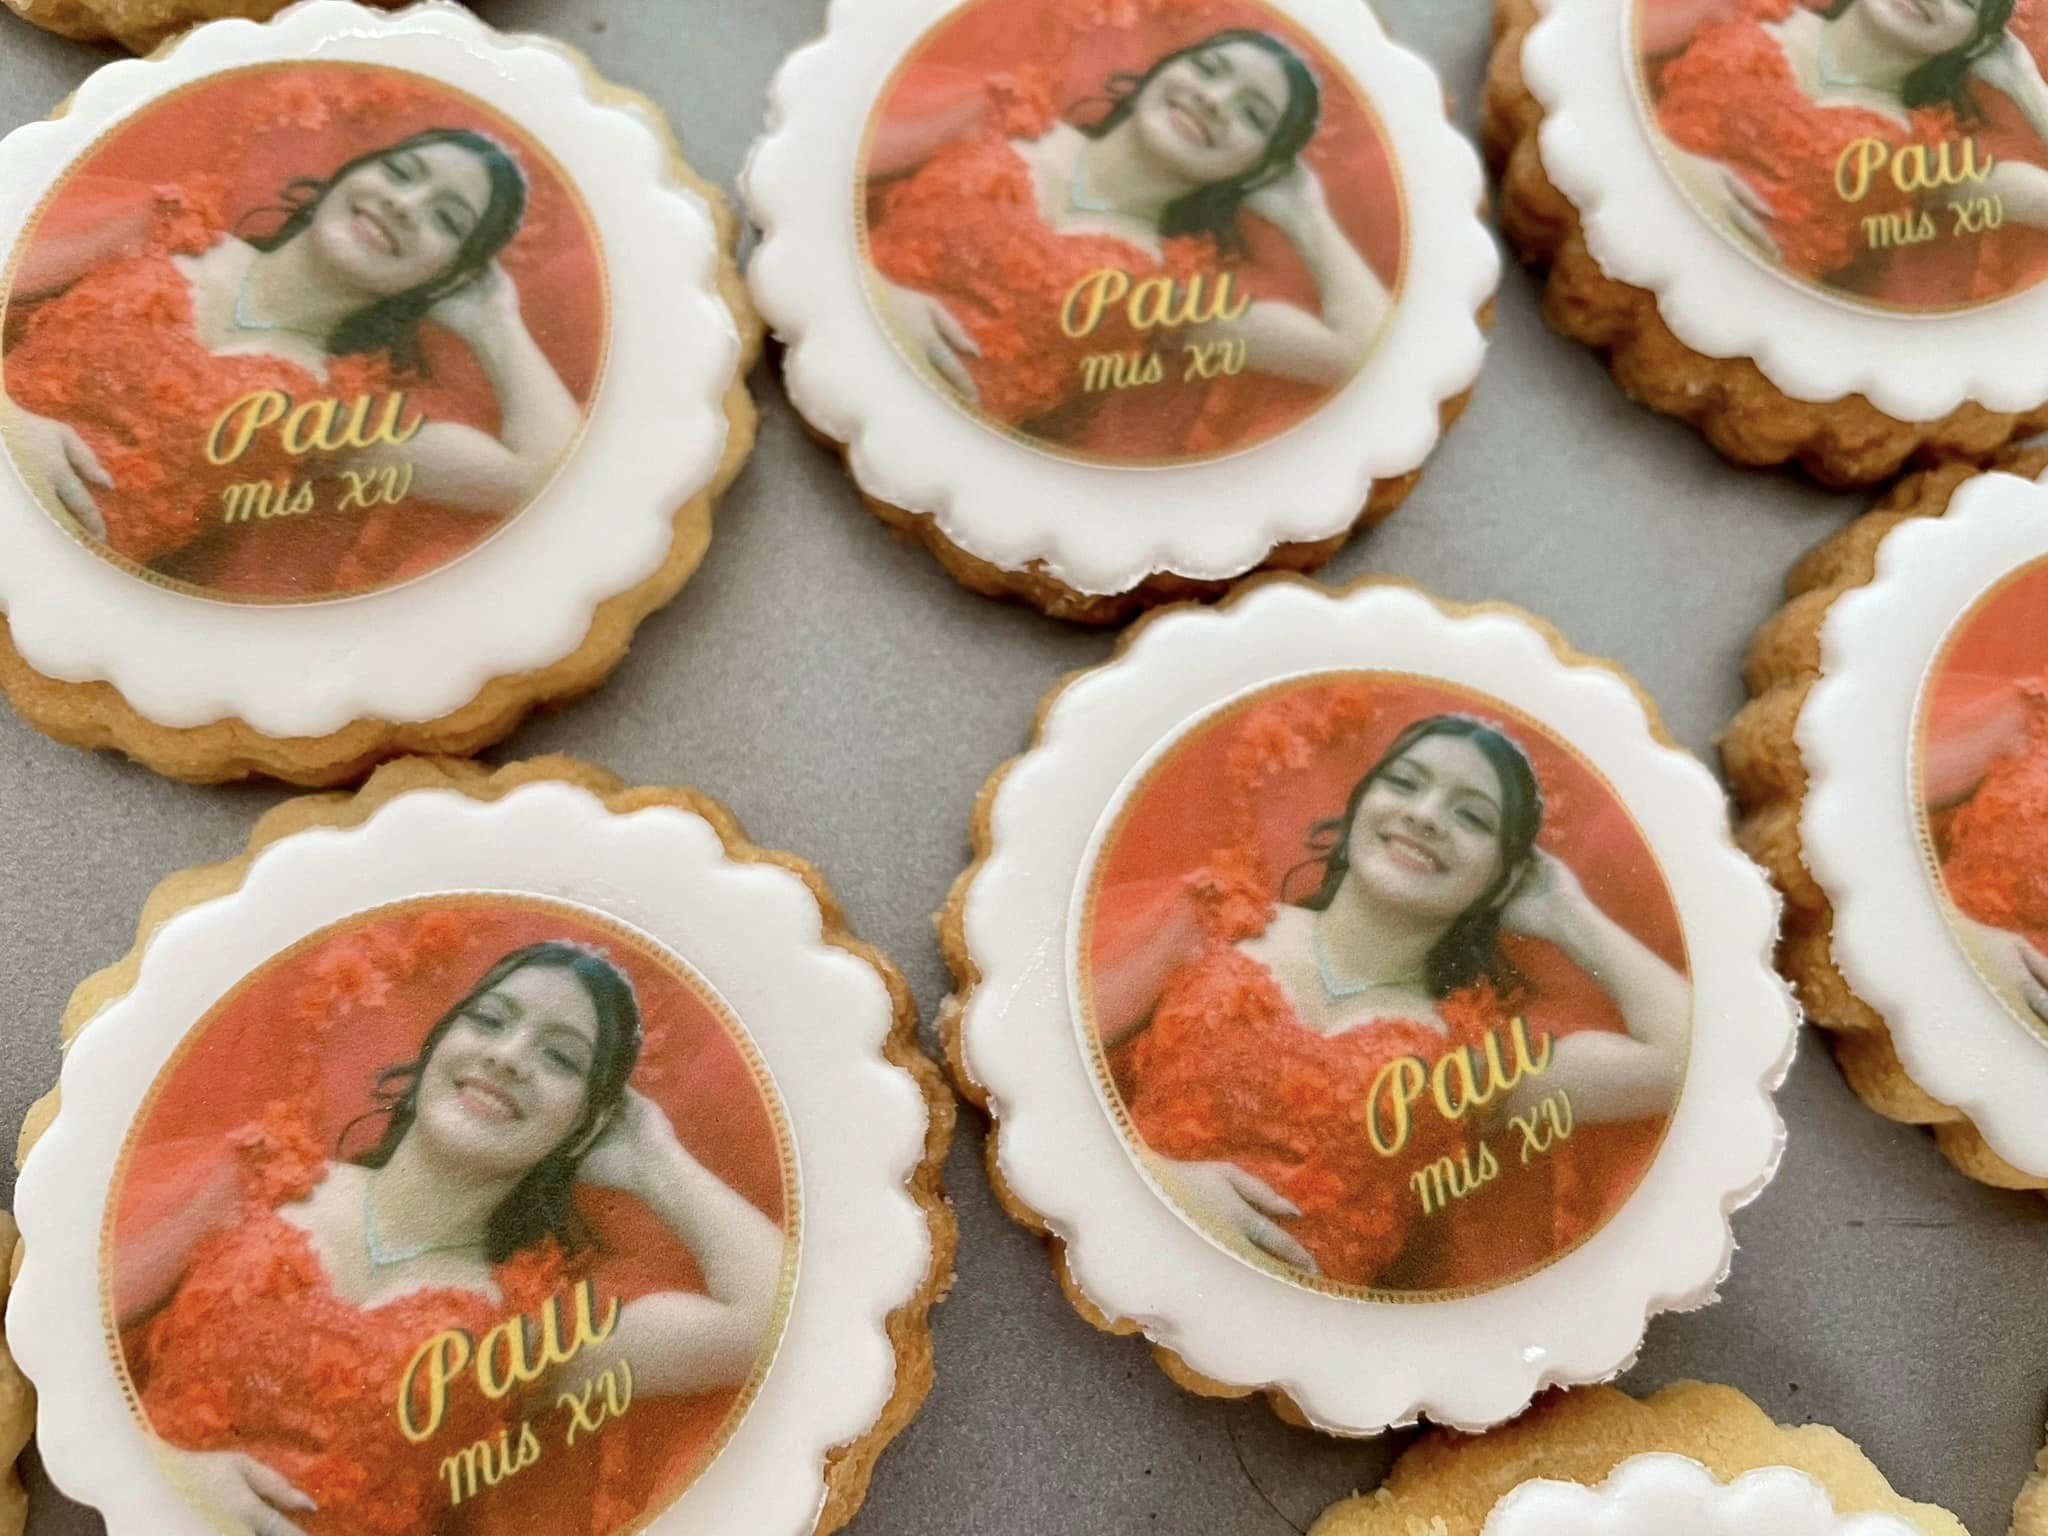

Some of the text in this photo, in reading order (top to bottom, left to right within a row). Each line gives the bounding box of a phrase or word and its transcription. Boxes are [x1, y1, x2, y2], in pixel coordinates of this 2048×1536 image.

[1836, 137, 1993, 202] Pau
[1948, 196, 2003, 237] XV
[1062, 268, 1251, 337] Pau
[1183, 338, 1248, 381] XV
[206, 390, 423, 465] Pau
[337, 463, 413, 510] XV
[1366, 1017, 1553, 1155] Pau
[1508, 1088, 1575, 1164] XV
[398, 1280, 620, 1443] Pau
[557, 1358, 632, 1445] XV
